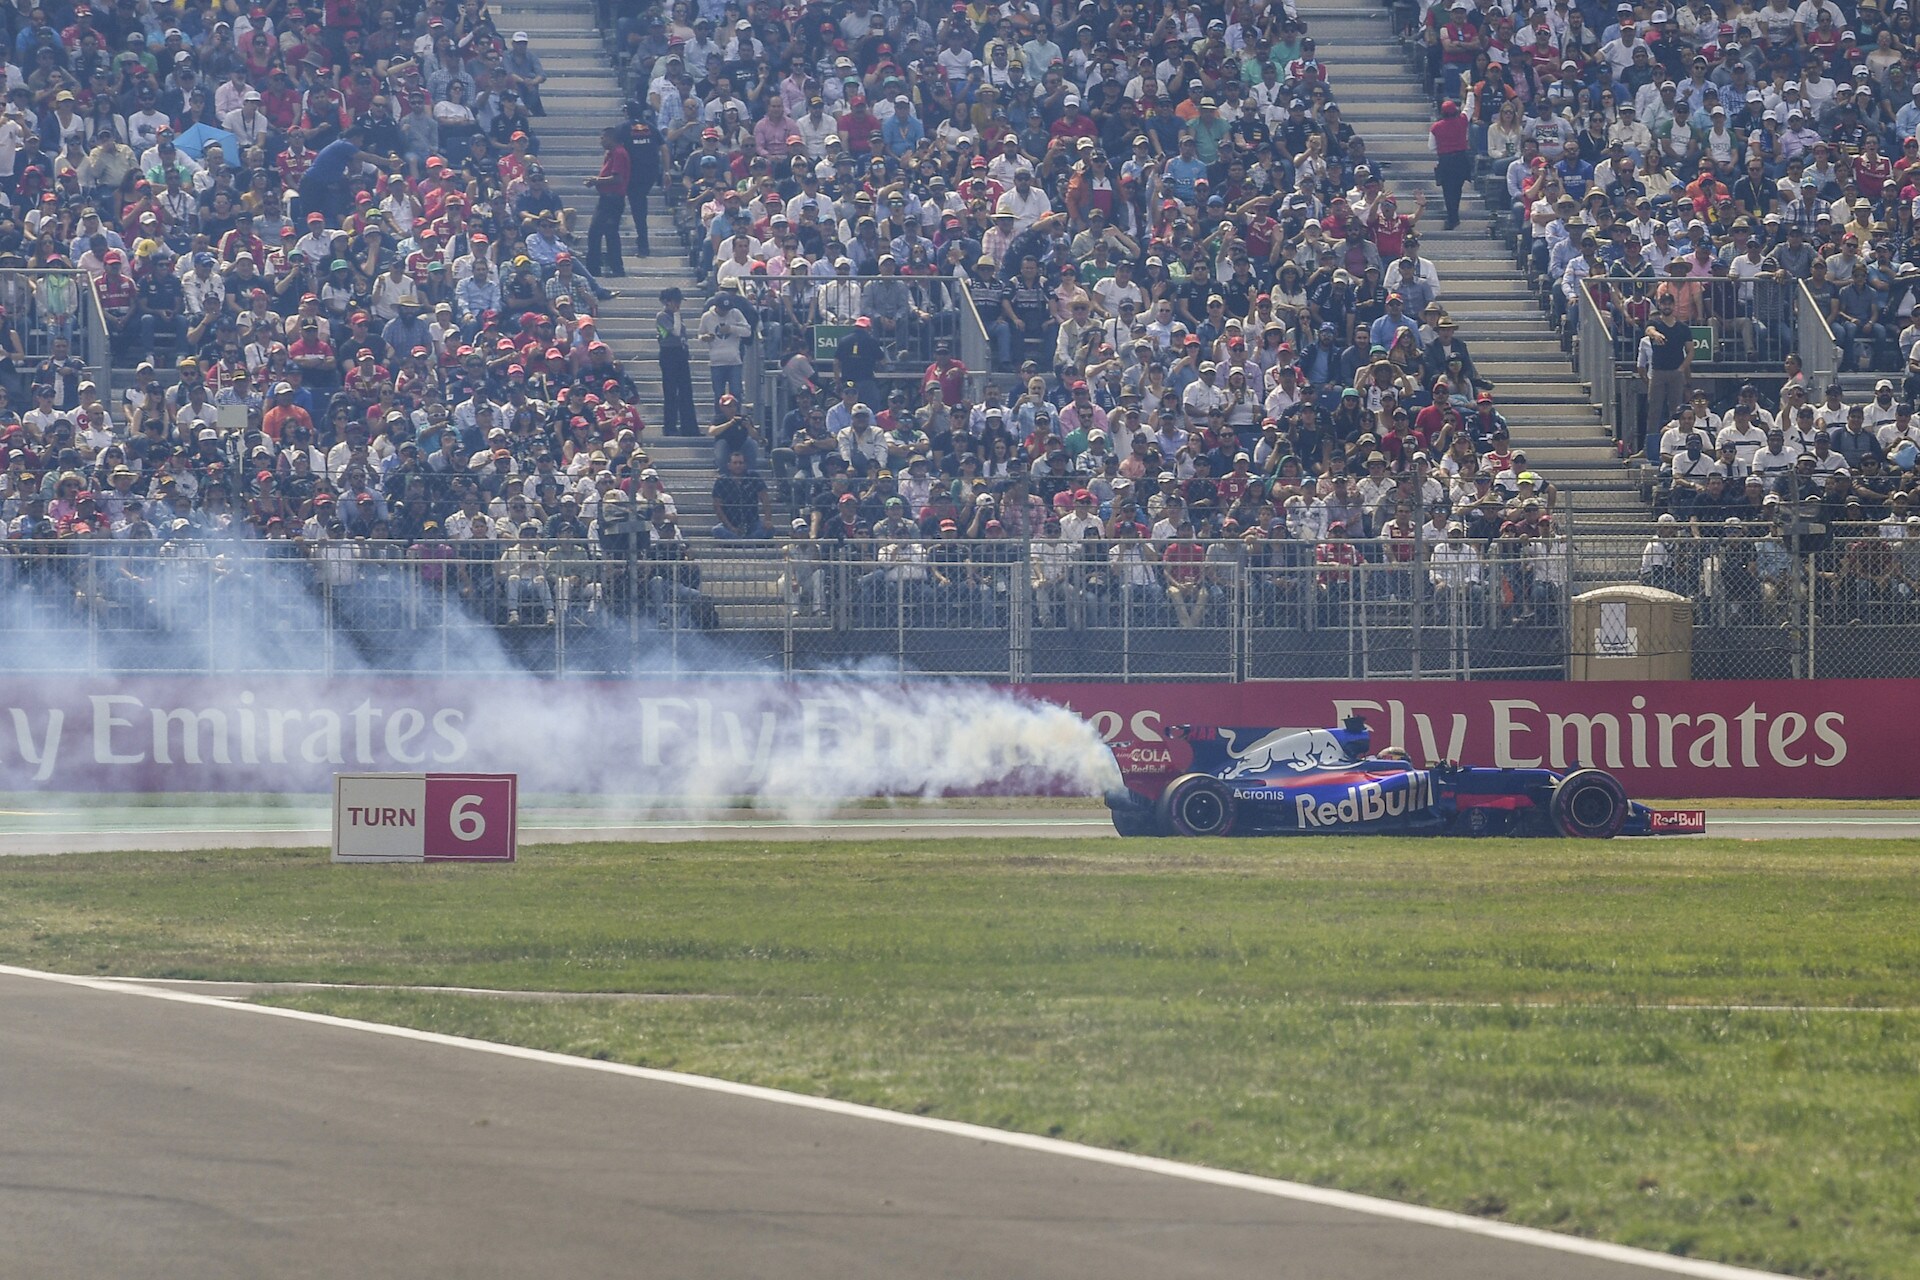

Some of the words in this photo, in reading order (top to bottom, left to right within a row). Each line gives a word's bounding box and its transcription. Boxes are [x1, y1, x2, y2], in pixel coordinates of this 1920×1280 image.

[88, 690, 469, 765] Emirates
[638, 697, 776, 784] Fly
[1131, 748, 1172, 763] COLA
[1489, 695, 1849, 769] Emirates
[347, 807, 416, 827] TURN
[450, 794, 486, 842] 6
[1233, 788, 1285, 801] Acronis
